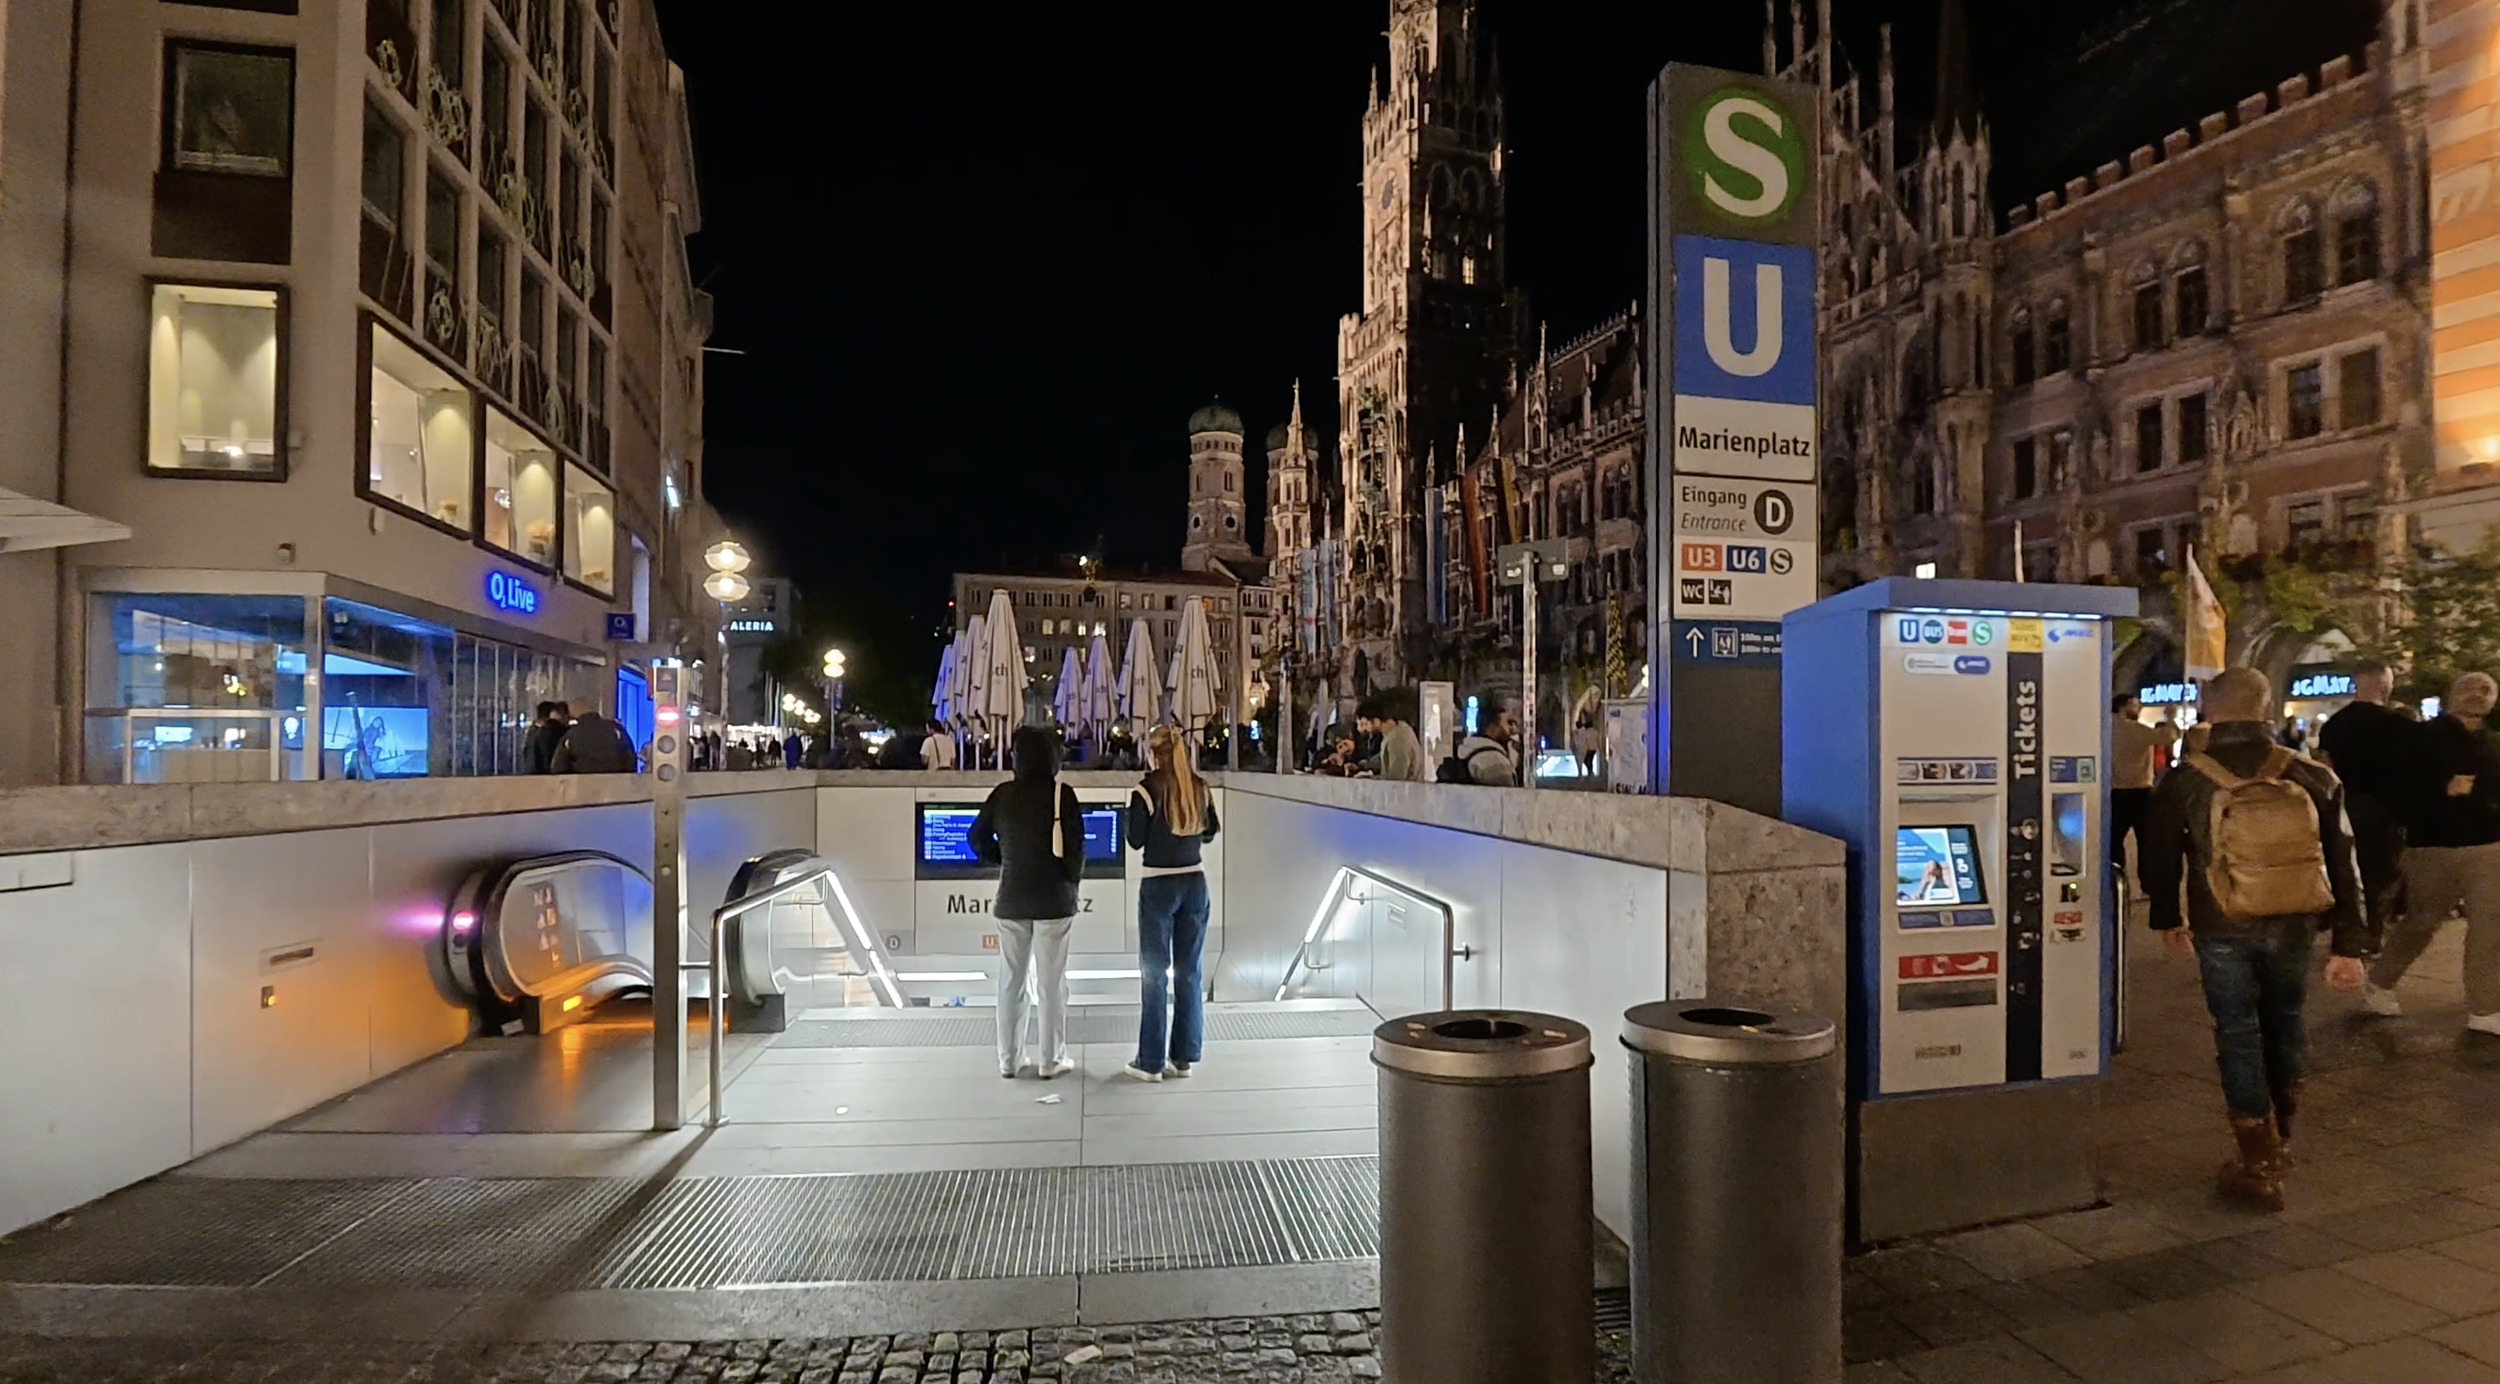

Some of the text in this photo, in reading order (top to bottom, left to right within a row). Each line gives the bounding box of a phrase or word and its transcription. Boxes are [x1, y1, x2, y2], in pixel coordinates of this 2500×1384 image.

[1704, 98, 1788, 217] S
[1703, 257, 1782, 376] U
[1679, 426, 1810, 459] Marienplatz
[1682, 486, 1747, 509] Eingang
[1681, 513, 1747, 532] Entrance
[1688, 548, 1792, 573] U3 U6 S
[508, 578, 534, 612] Live
[1683, 584, 1704, 600] WC
[730, 621, 774, 631] ALERIA
[1903, 621, 1916, 640] U
[1975, 622, 1991, 644] S
[2014, 681, 2036, 779] Tickets
